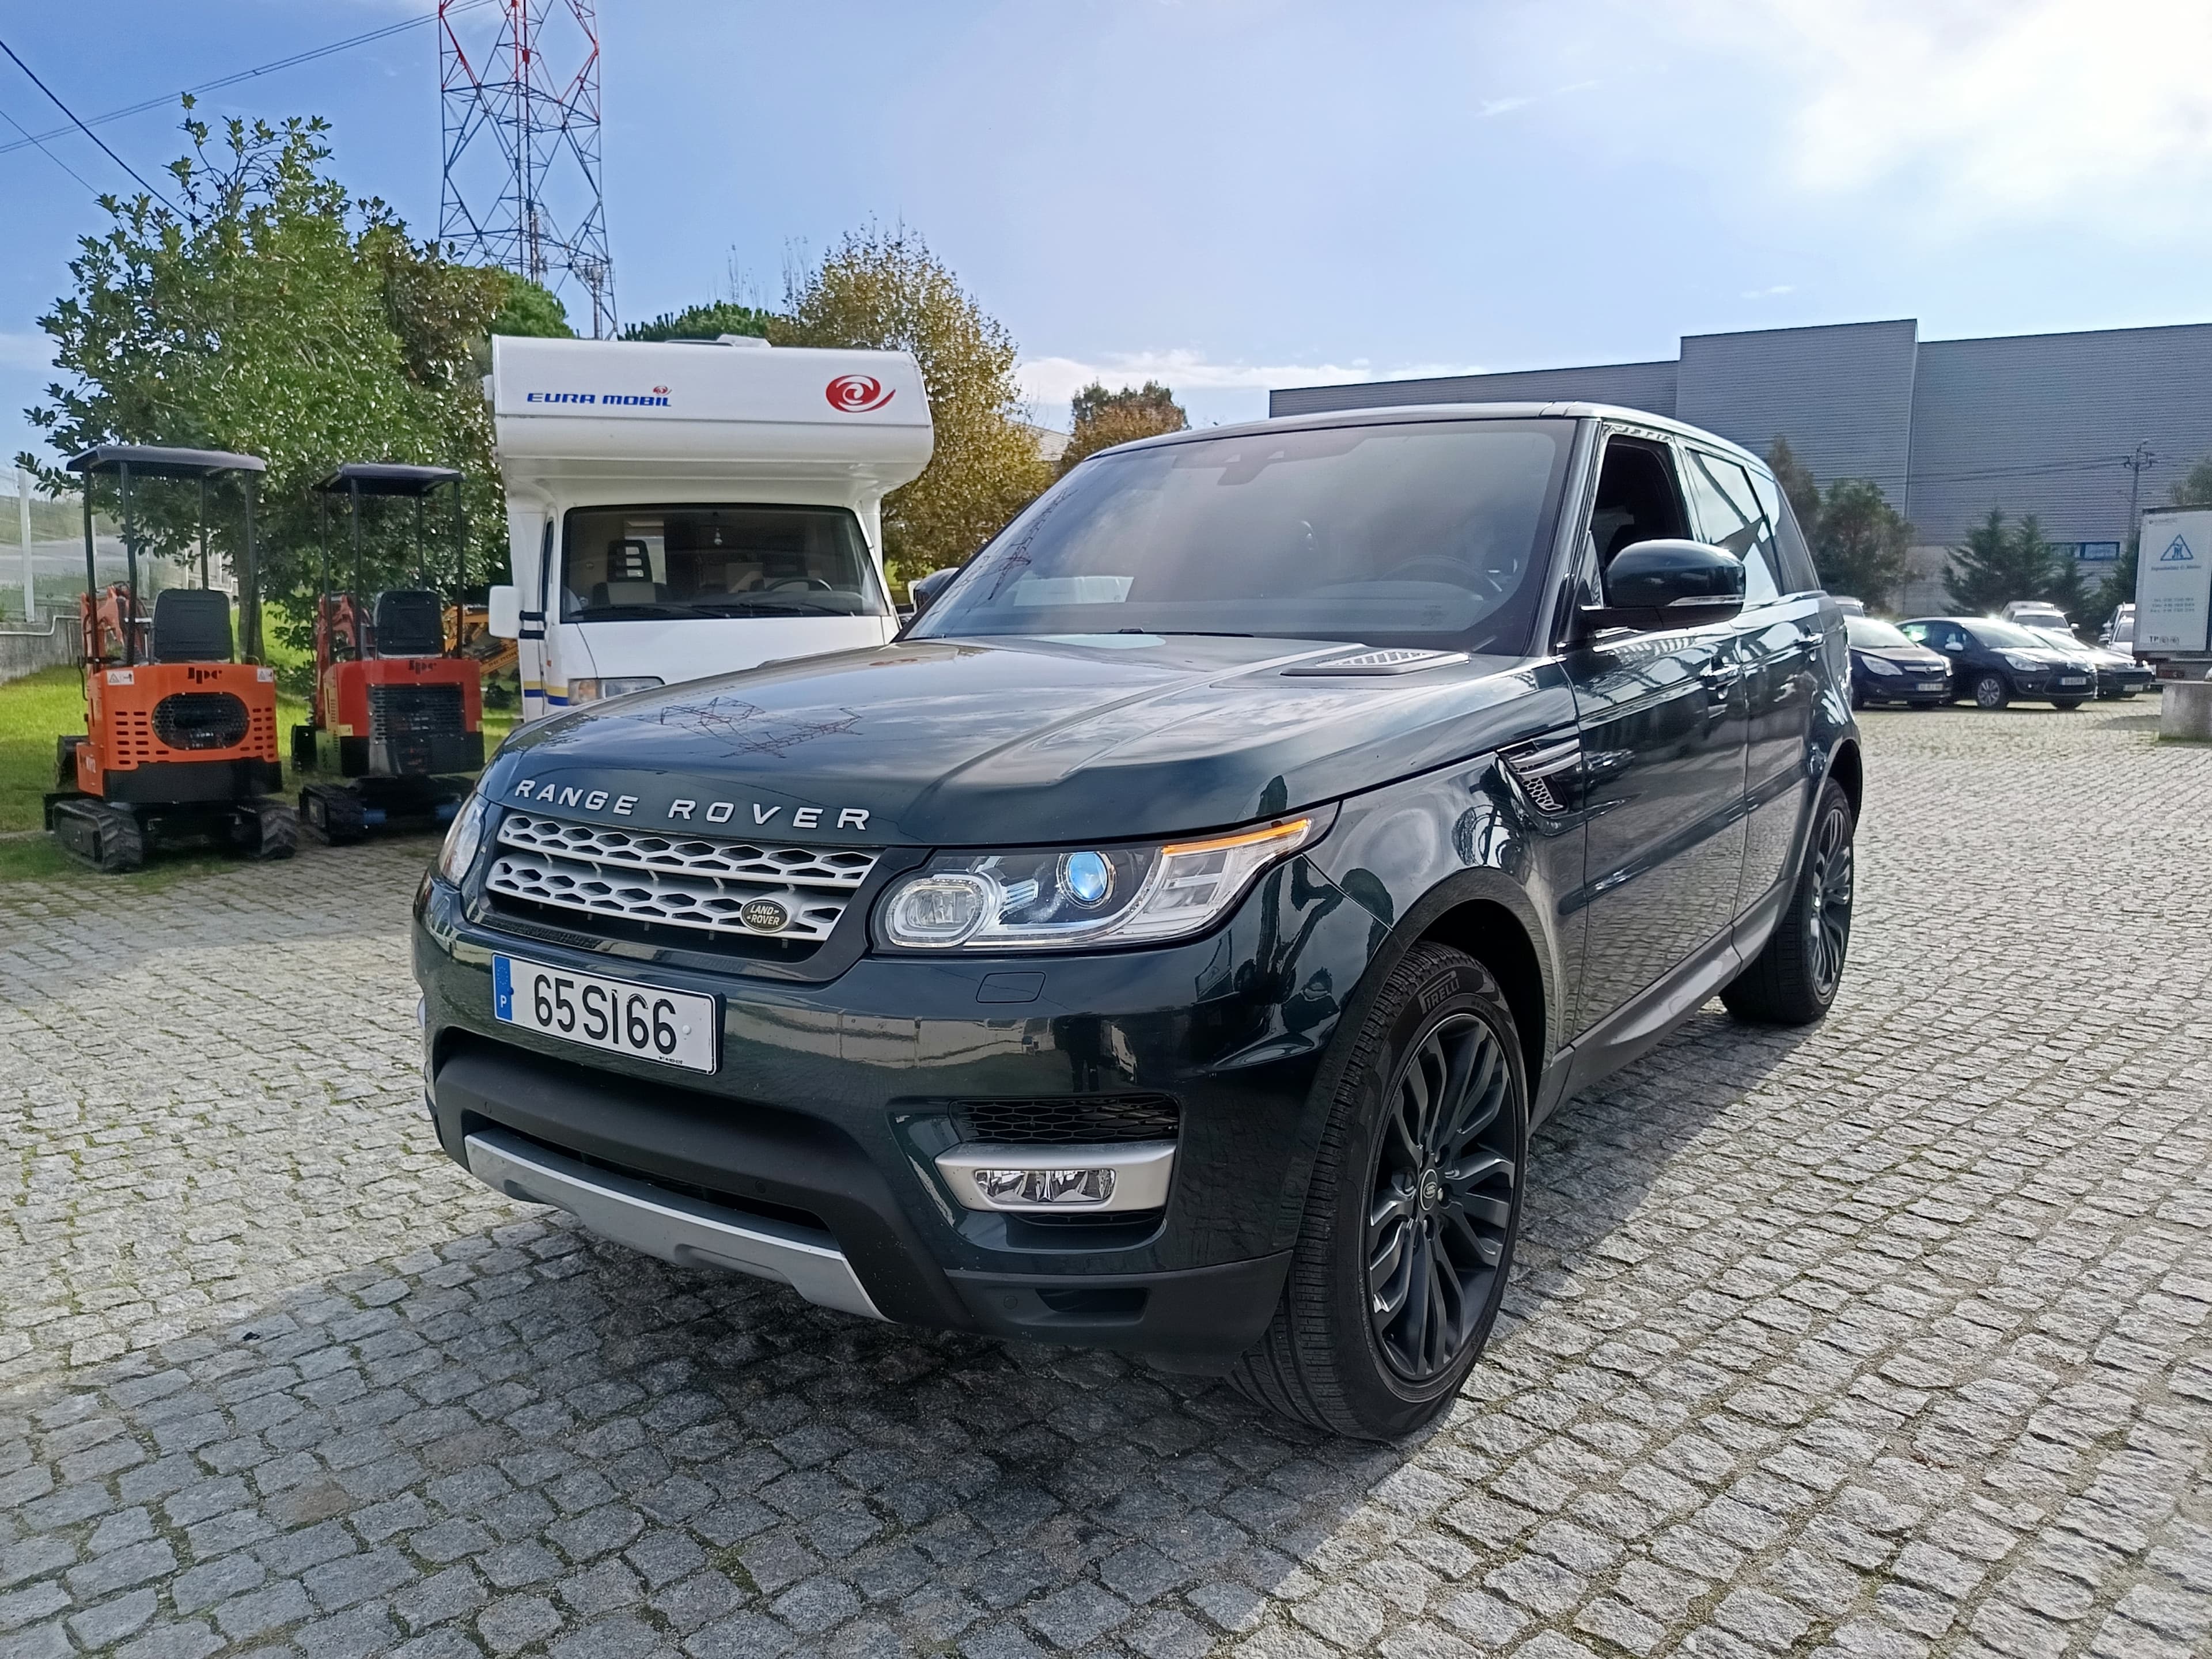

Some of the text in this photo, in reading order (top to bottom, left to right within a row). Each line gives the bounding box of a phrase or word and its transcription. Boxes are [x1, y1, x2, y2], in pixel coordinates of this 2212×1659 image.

[527, 393, 672, 407] EURA MOBIL
[515, 779, 870, 830] RANGE ROVER
[749, 904, 774, 915] LAND
[750, 914, 781, 926] ROVER
[1418, 970, 1460, 1014] PIRELLI
[500, 994, 507, 1009] P
